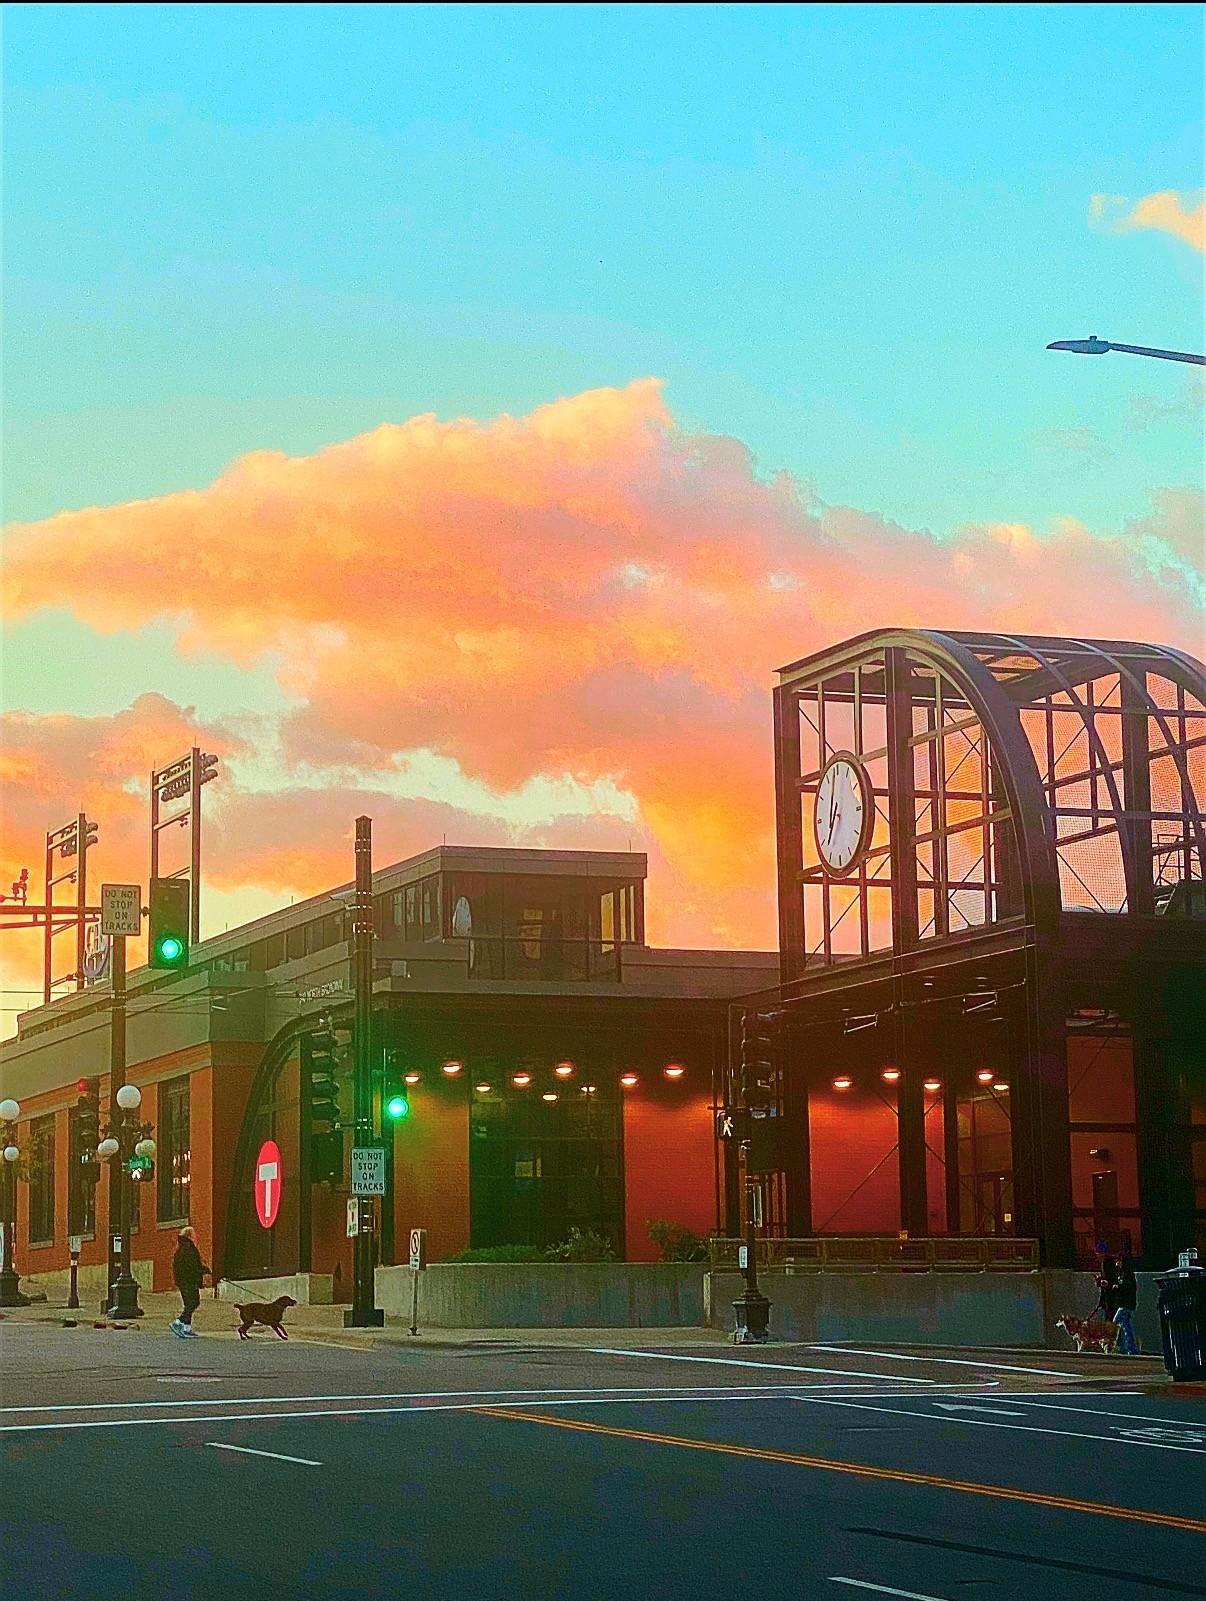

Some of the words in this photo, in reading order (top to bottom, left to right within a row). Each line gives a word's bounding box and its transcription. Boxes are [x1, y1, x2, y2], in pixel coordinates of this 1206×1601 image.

[104, 889, 116, 898] DO
[121, 889, 137, 898] NOT
[110, 900, 132, 909] STOP
[115, 911, 128, 920] ON
[104, 921, 138, 930] TRACKS
[353, 1152, 364, 1160] DO
[367, 1152, 382, 1160] NOT
[358, 1162, 378, 1171] STOP
[362, 1171, 375, 1180] ON
[353, 1182, 384, 1191] TRACKS
